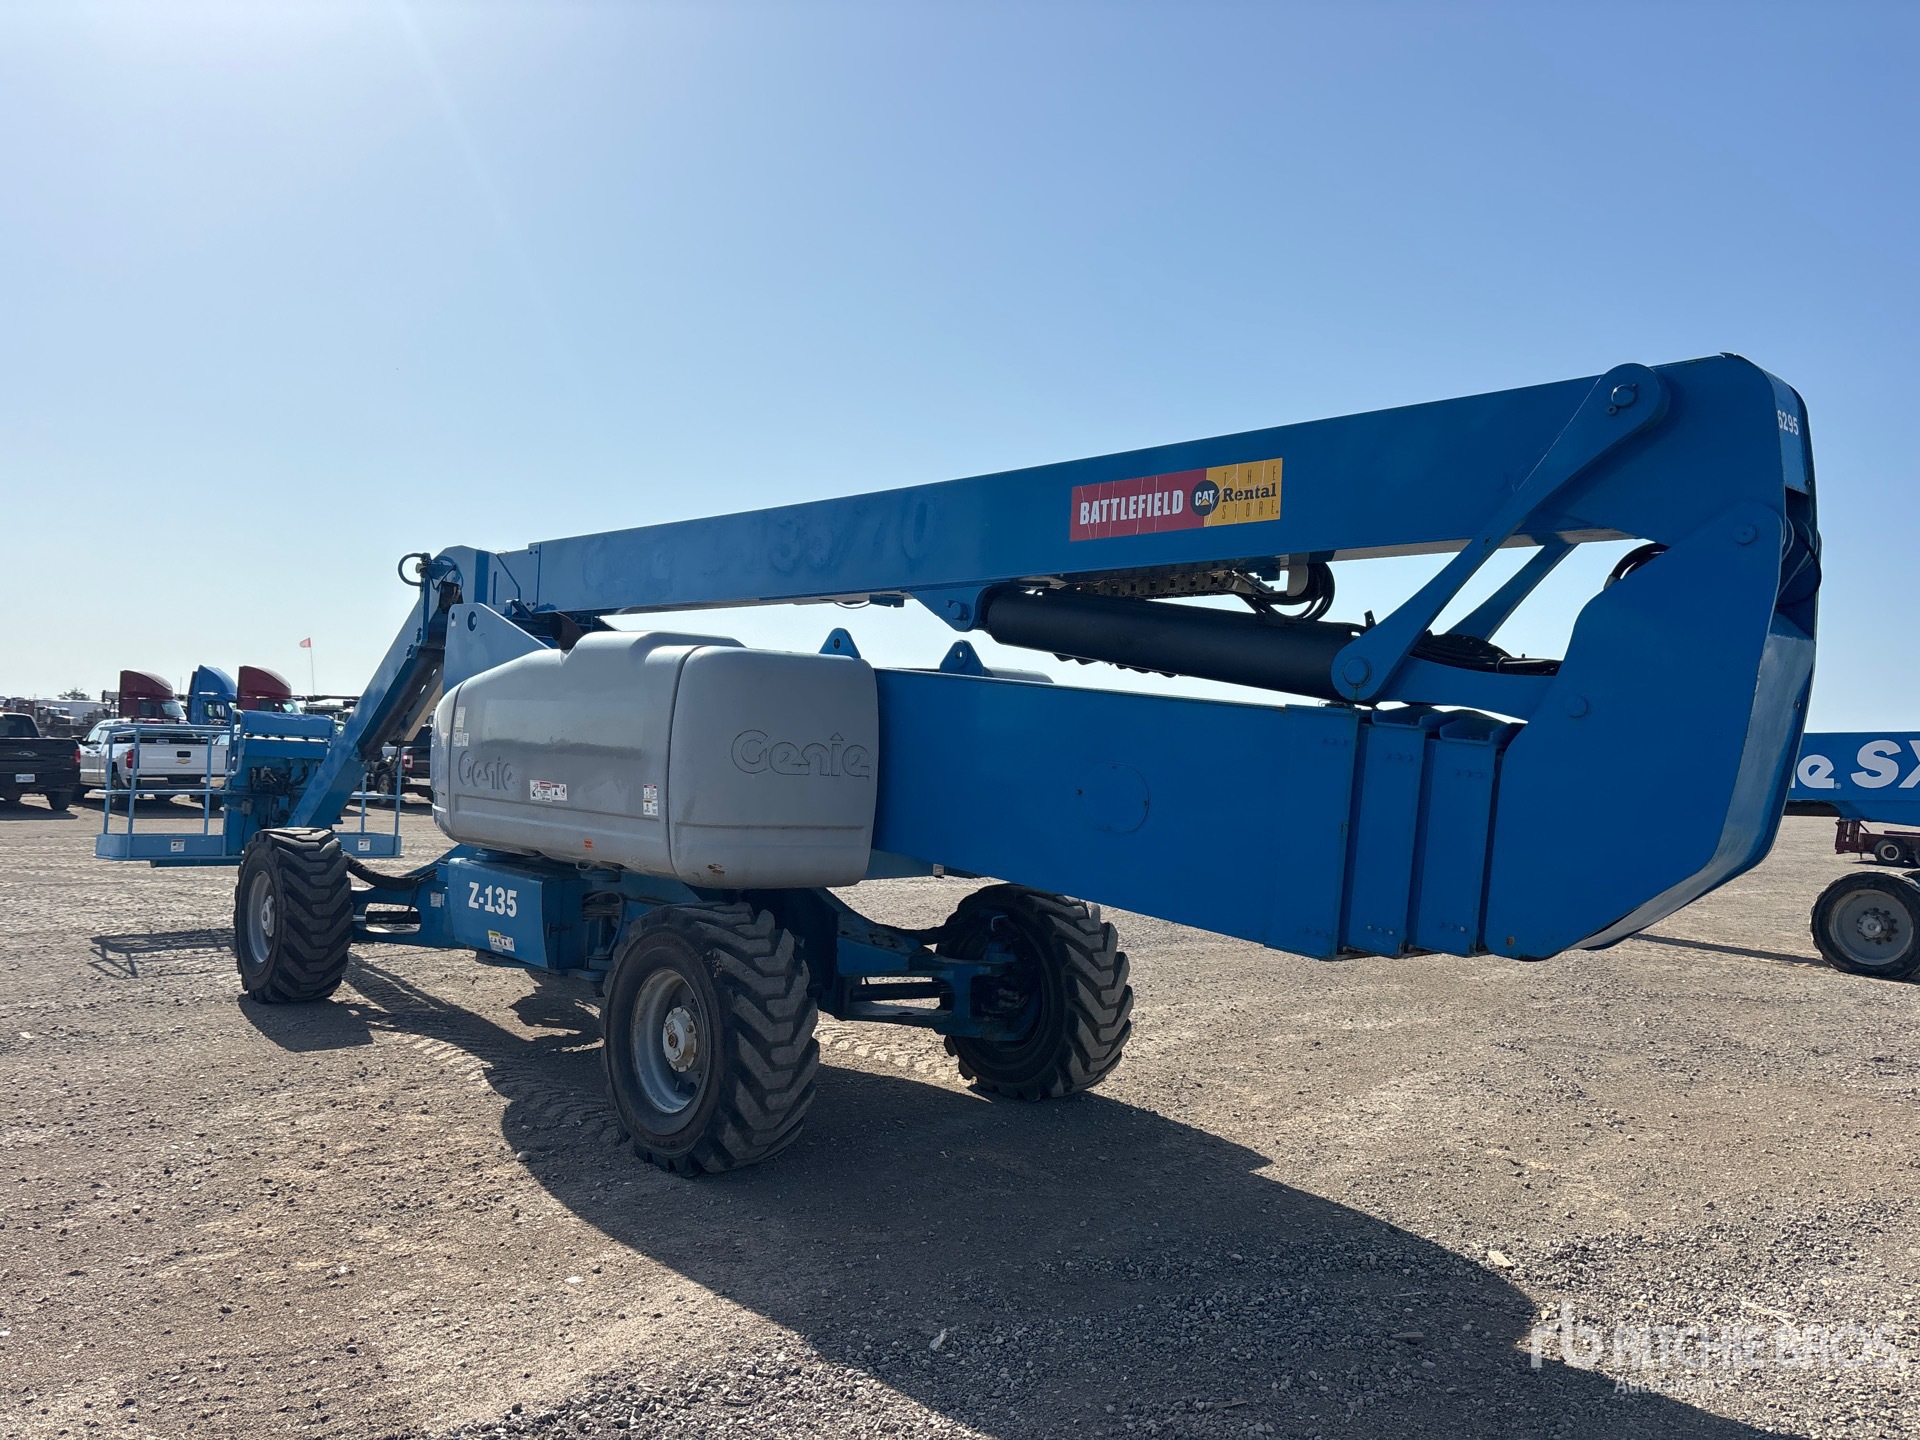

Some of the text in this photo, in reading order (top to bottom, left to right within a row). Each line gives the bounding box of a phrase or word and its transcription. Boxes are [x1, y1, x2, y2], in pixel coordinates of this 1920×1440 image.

[1778, 410, 1799, 435] 6295
[1081, 484, 1276, 525] BATTLEFIELD CAT Rental
[458, 750, 517, 792] Genie
[731, 729, 874, 780] Genie
[468, 881, 518, 918] Z-135
